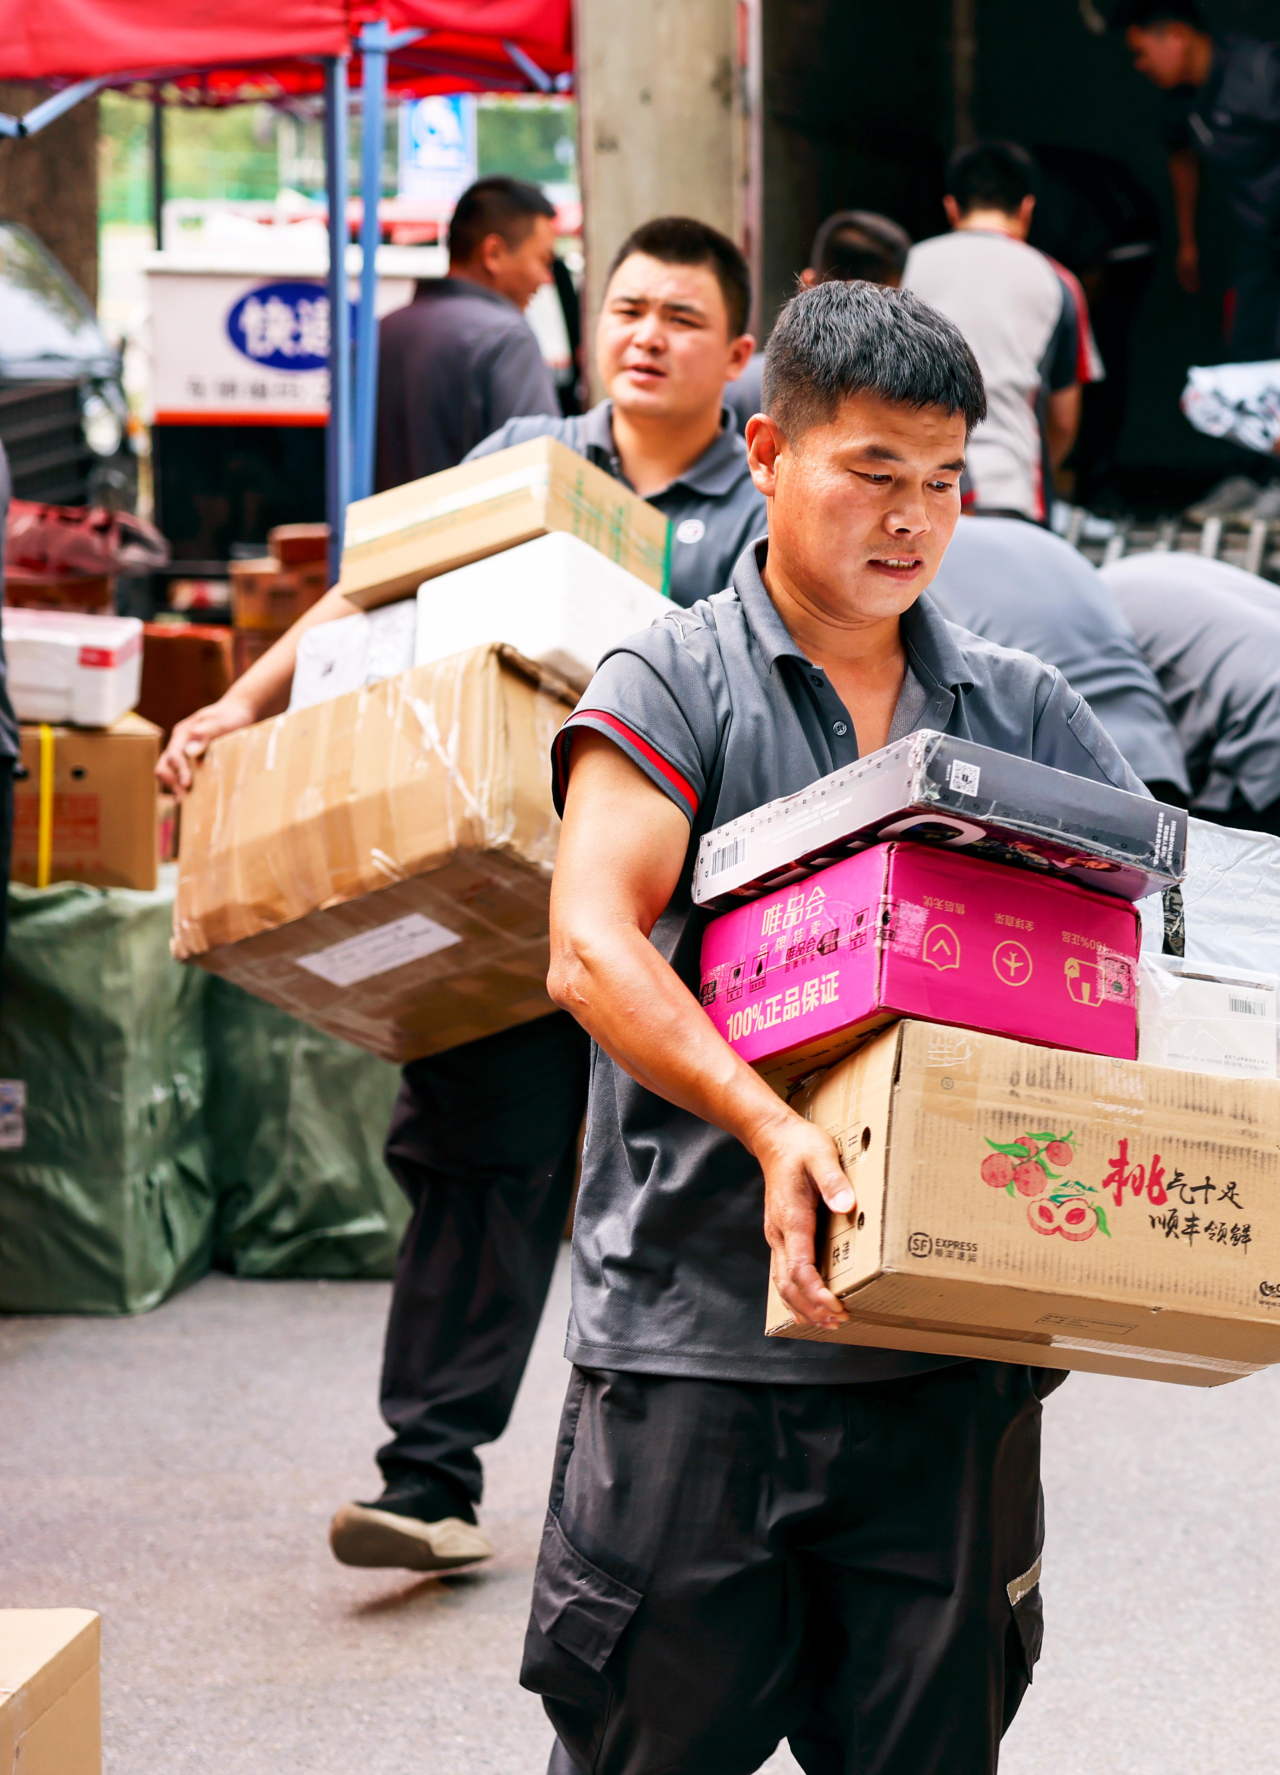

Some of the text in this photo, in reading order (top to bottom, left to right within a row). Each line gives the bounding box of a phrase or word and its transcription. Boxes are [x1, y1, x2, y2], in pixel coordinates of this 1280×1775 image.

[761, 886, 826, 937] 唯品会
[922, 895, 966, 916] 售后无忧
[994, 912, 1035, 932] 全球直采
[758, 920, 822, 956] 品牌特卖
[726, 970, 840, 1043] 100%正品保证
[1102, 1137, 1244, 1209] 桃气十足
[935, 1238, 978, 1252] EXPRESS
[1149, 1207, 1252, 1255] 顺丰领鲜
